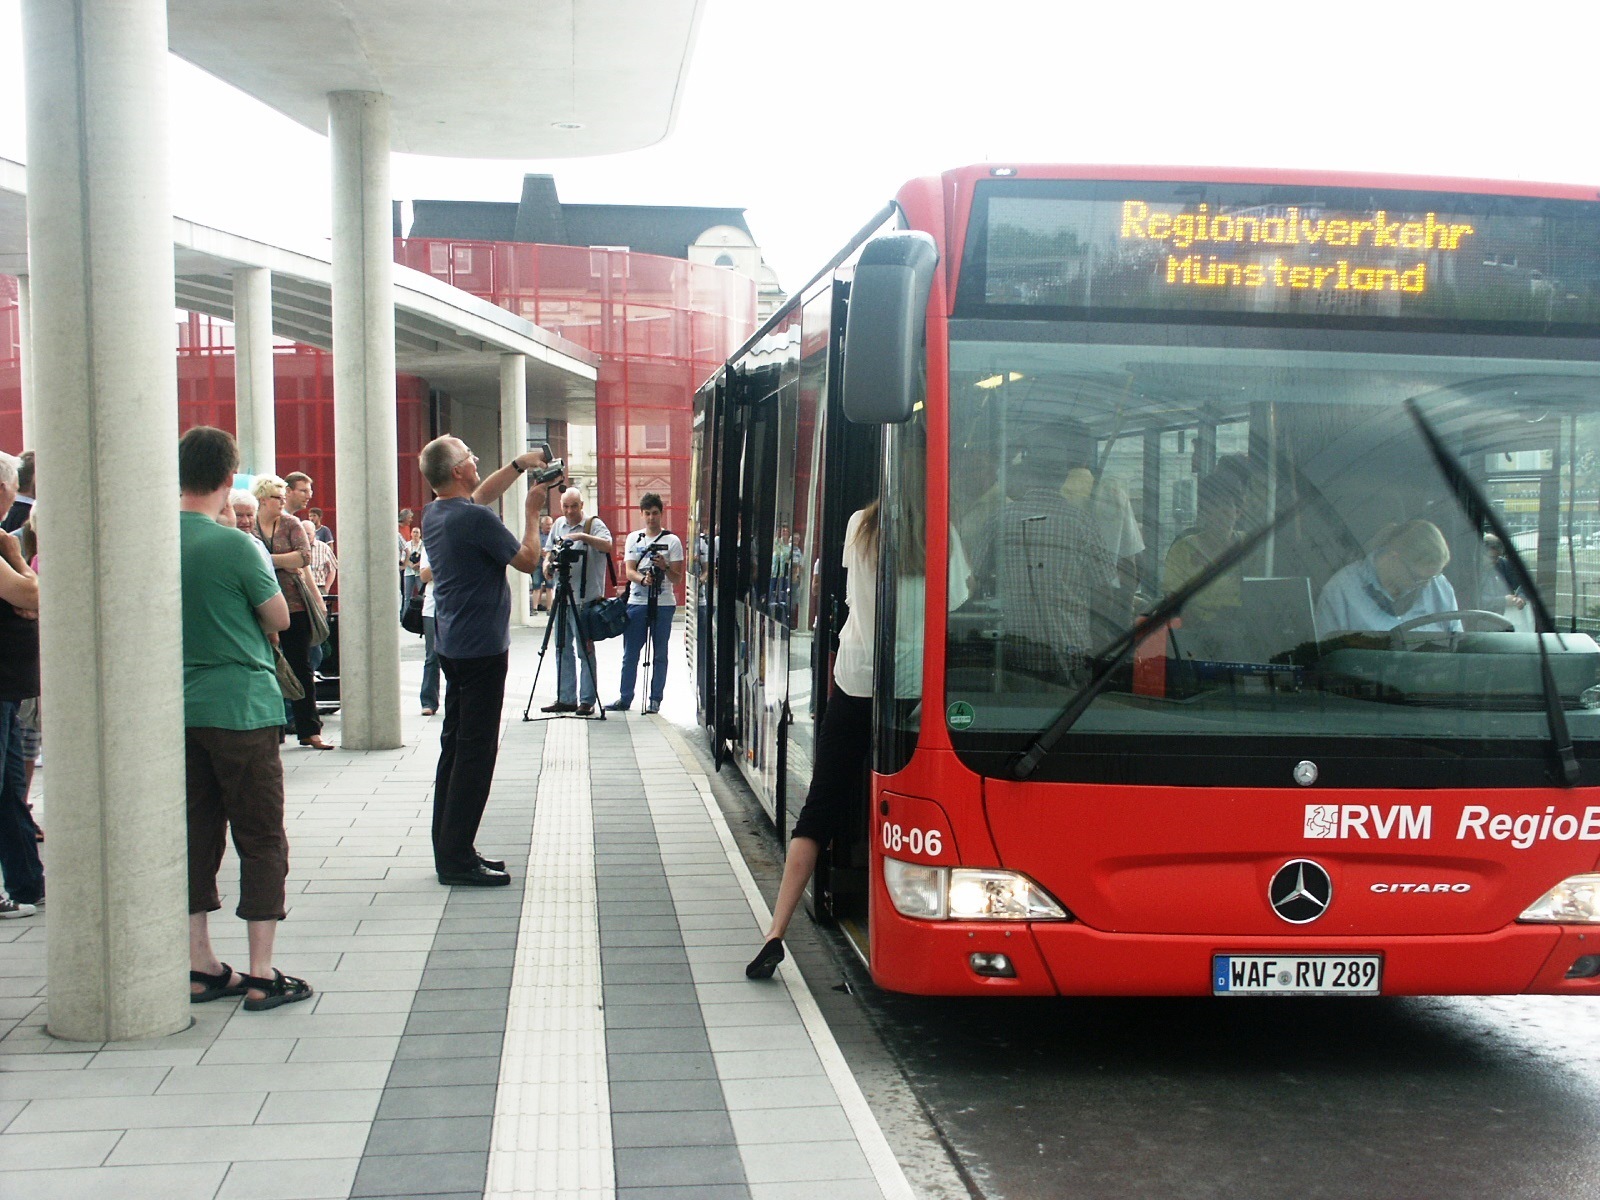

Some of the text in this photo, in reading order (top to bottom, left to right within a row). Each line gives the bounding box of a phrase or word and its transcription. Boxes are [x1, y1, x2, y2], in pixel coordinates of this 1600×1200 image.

[1121, 200, 1473, 249] Regionalverkehr
[1167, 255, 1426, 292] Münsterland
[957, 703, 965, 716] 4
[883, 821, 942, 856] 08-06
[1340, 805, 1432, 839] RVM
[1456, 805, 1600, 849] RegioB
[1370, 883, 1471, 893] CITARO
[1218, 961, 1376, 987] D WAF RV 289
